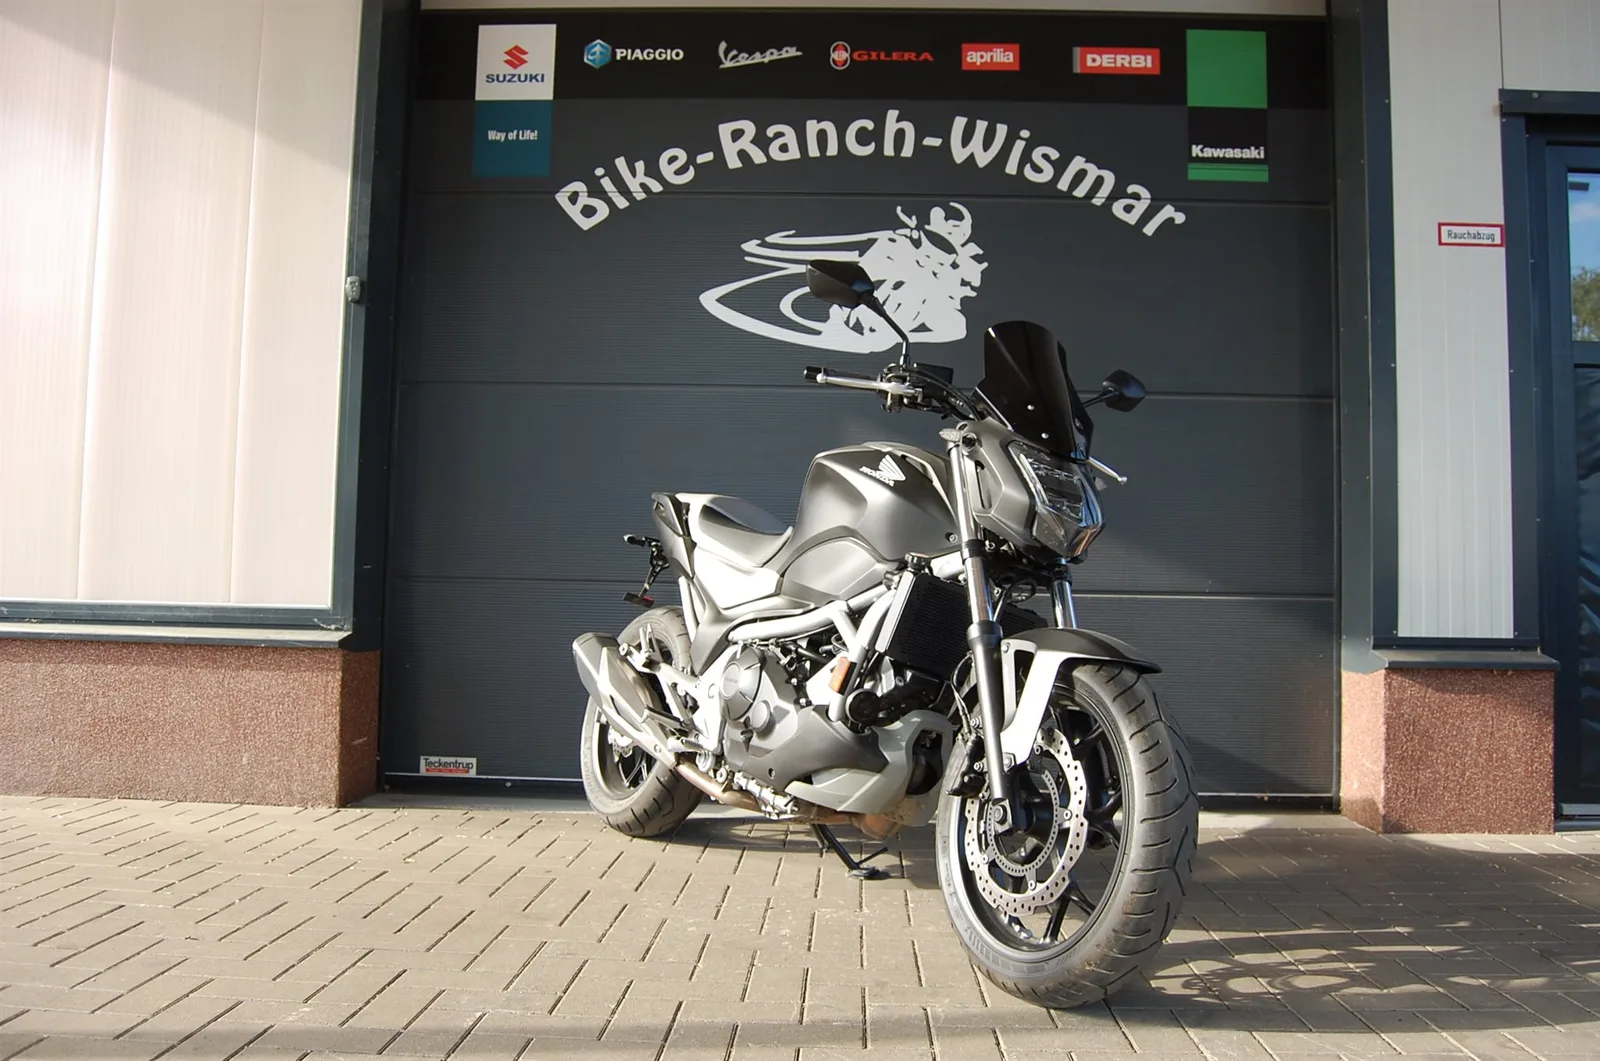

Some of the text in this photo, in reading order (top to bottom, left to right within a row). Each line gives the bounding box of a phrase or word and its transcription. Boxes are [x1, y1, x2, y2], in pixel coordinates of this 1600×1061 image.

[615, 48, 684, 61] PIAGGIO
[718, 40, 803, 69] Vespa
[852, 50, 934, 61] GILERA
[966, 48, 1014, 65] aprilia
[1086, 53, 1152, 68] DERBI
[485, 73, 545, 84] SUZUKI
[487, 129, 538, 143] Way of Life!
[1191, 144, 1265, 159] Kawasaki
[1447, 229, 1495, 242] Rauchabzug
[423, 757, 474, 770] Teckentrup
